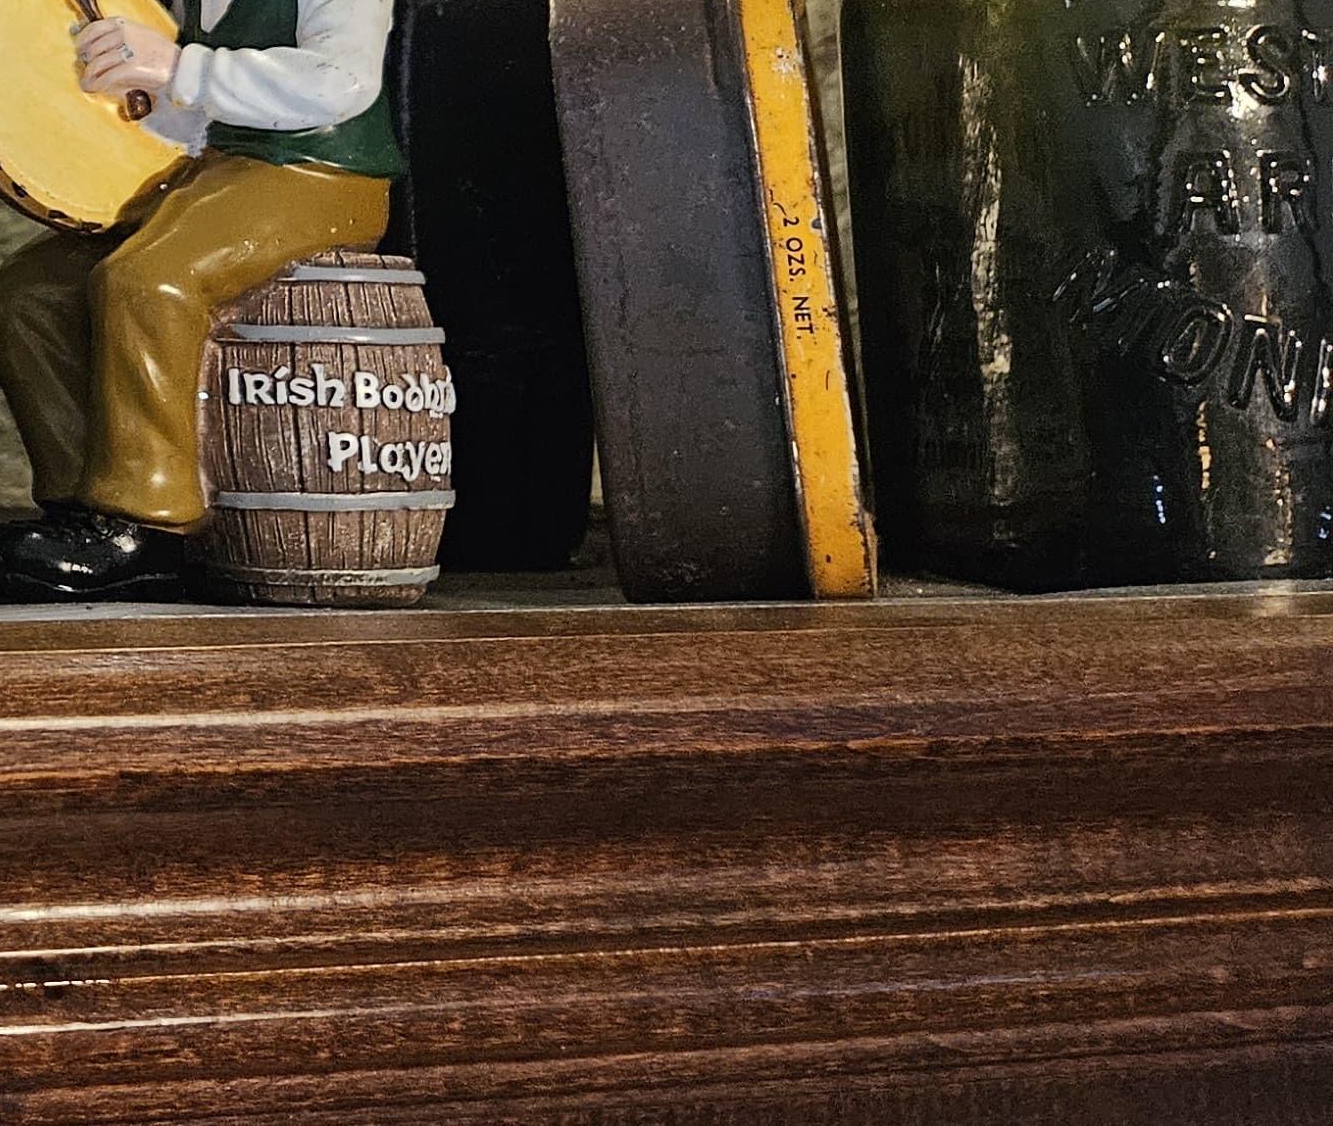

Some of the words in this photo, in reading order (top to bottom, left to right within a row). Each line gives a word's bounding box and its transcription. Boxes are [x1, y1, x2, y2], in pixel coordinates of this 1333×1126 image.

[783, 216, 800, 227] 2
[786, 237, 806, 282] OZS.
[792, 296, 814, 340] NET.
[228, 364, 346, 407] Irish
